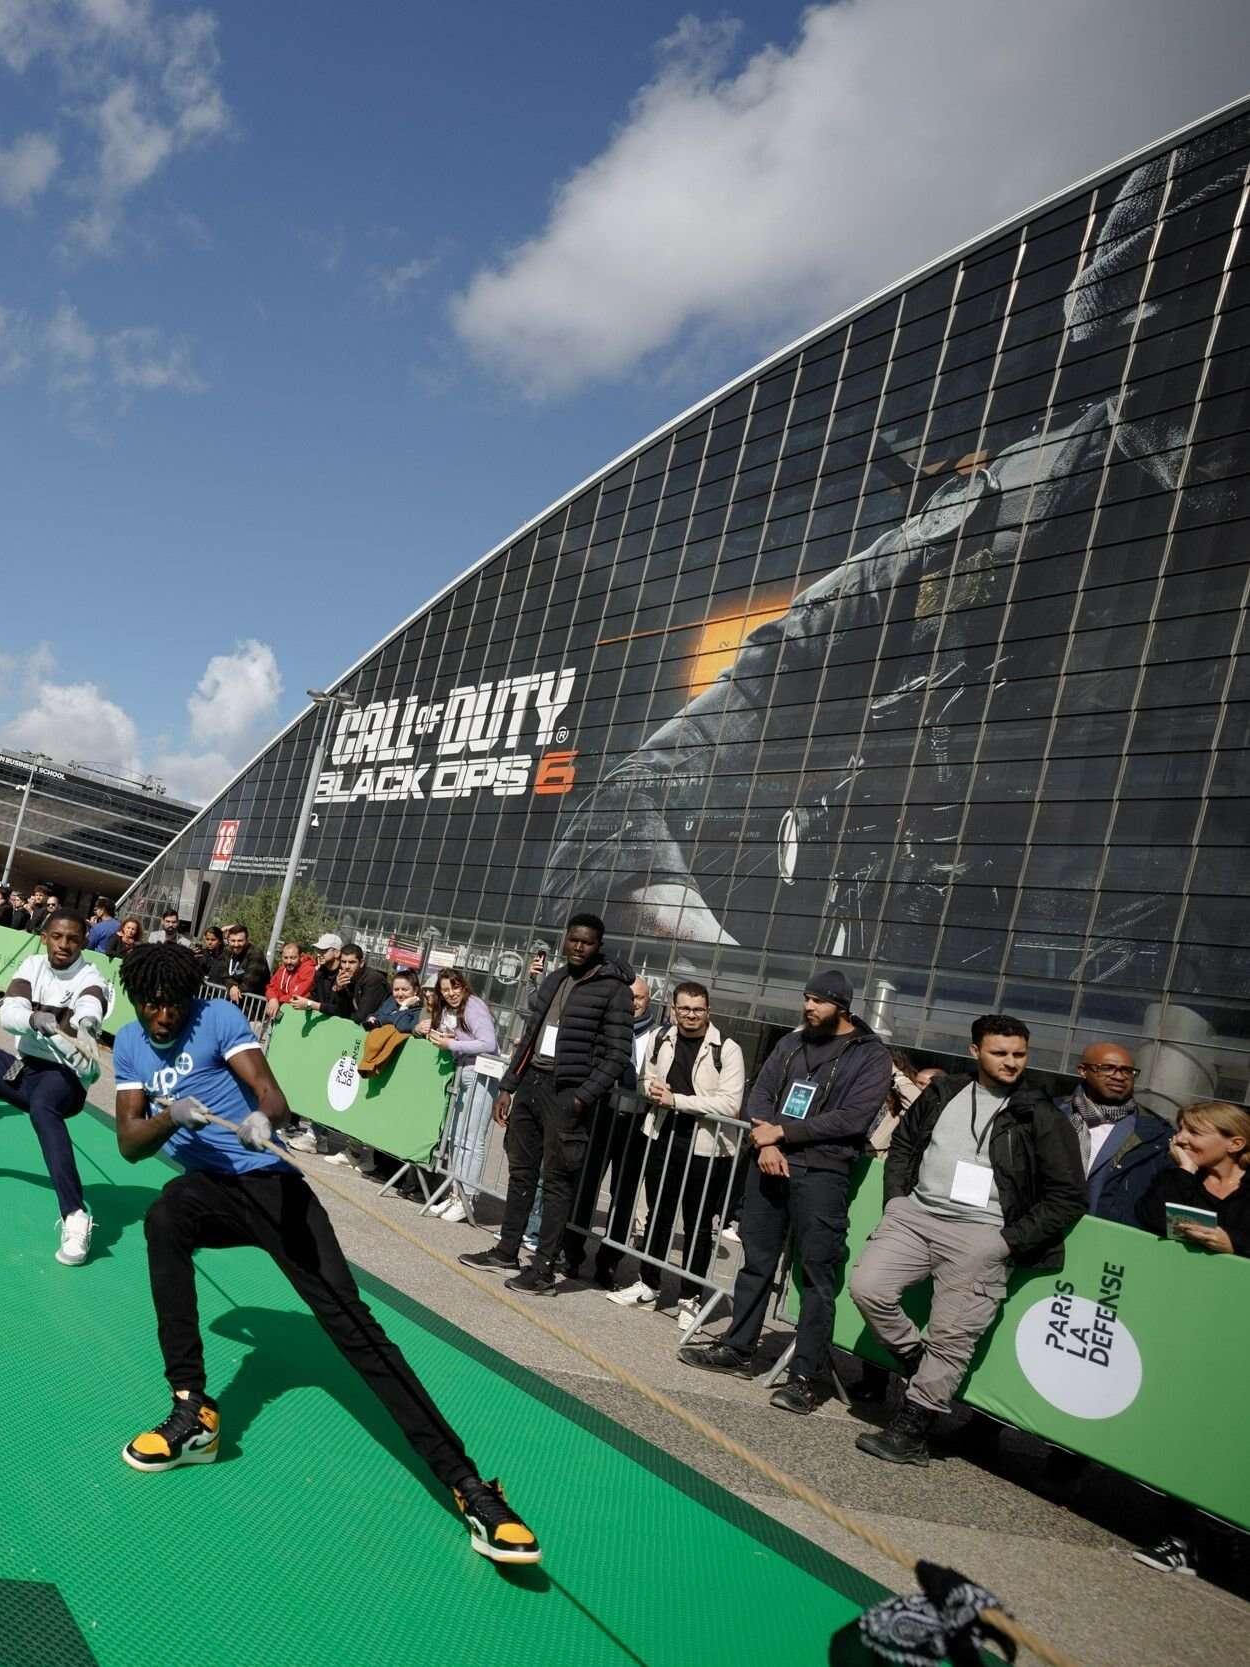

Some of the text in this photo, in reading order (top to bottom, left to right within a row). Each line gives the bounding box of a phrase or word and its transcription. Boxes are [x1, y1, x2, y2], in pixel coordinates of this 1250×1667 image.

[331, 667, 576, 766] CALL OF DUTY
[5, 757, 38, 772] BUSINESS
[38, 767, 66, 780] SCHOOL
[314, 751, 579, 804] BLACK OPS 6
[1089, 1262, 1125, 1368] DEFENSE
[1066, 1328, 1090, 1359] LA
